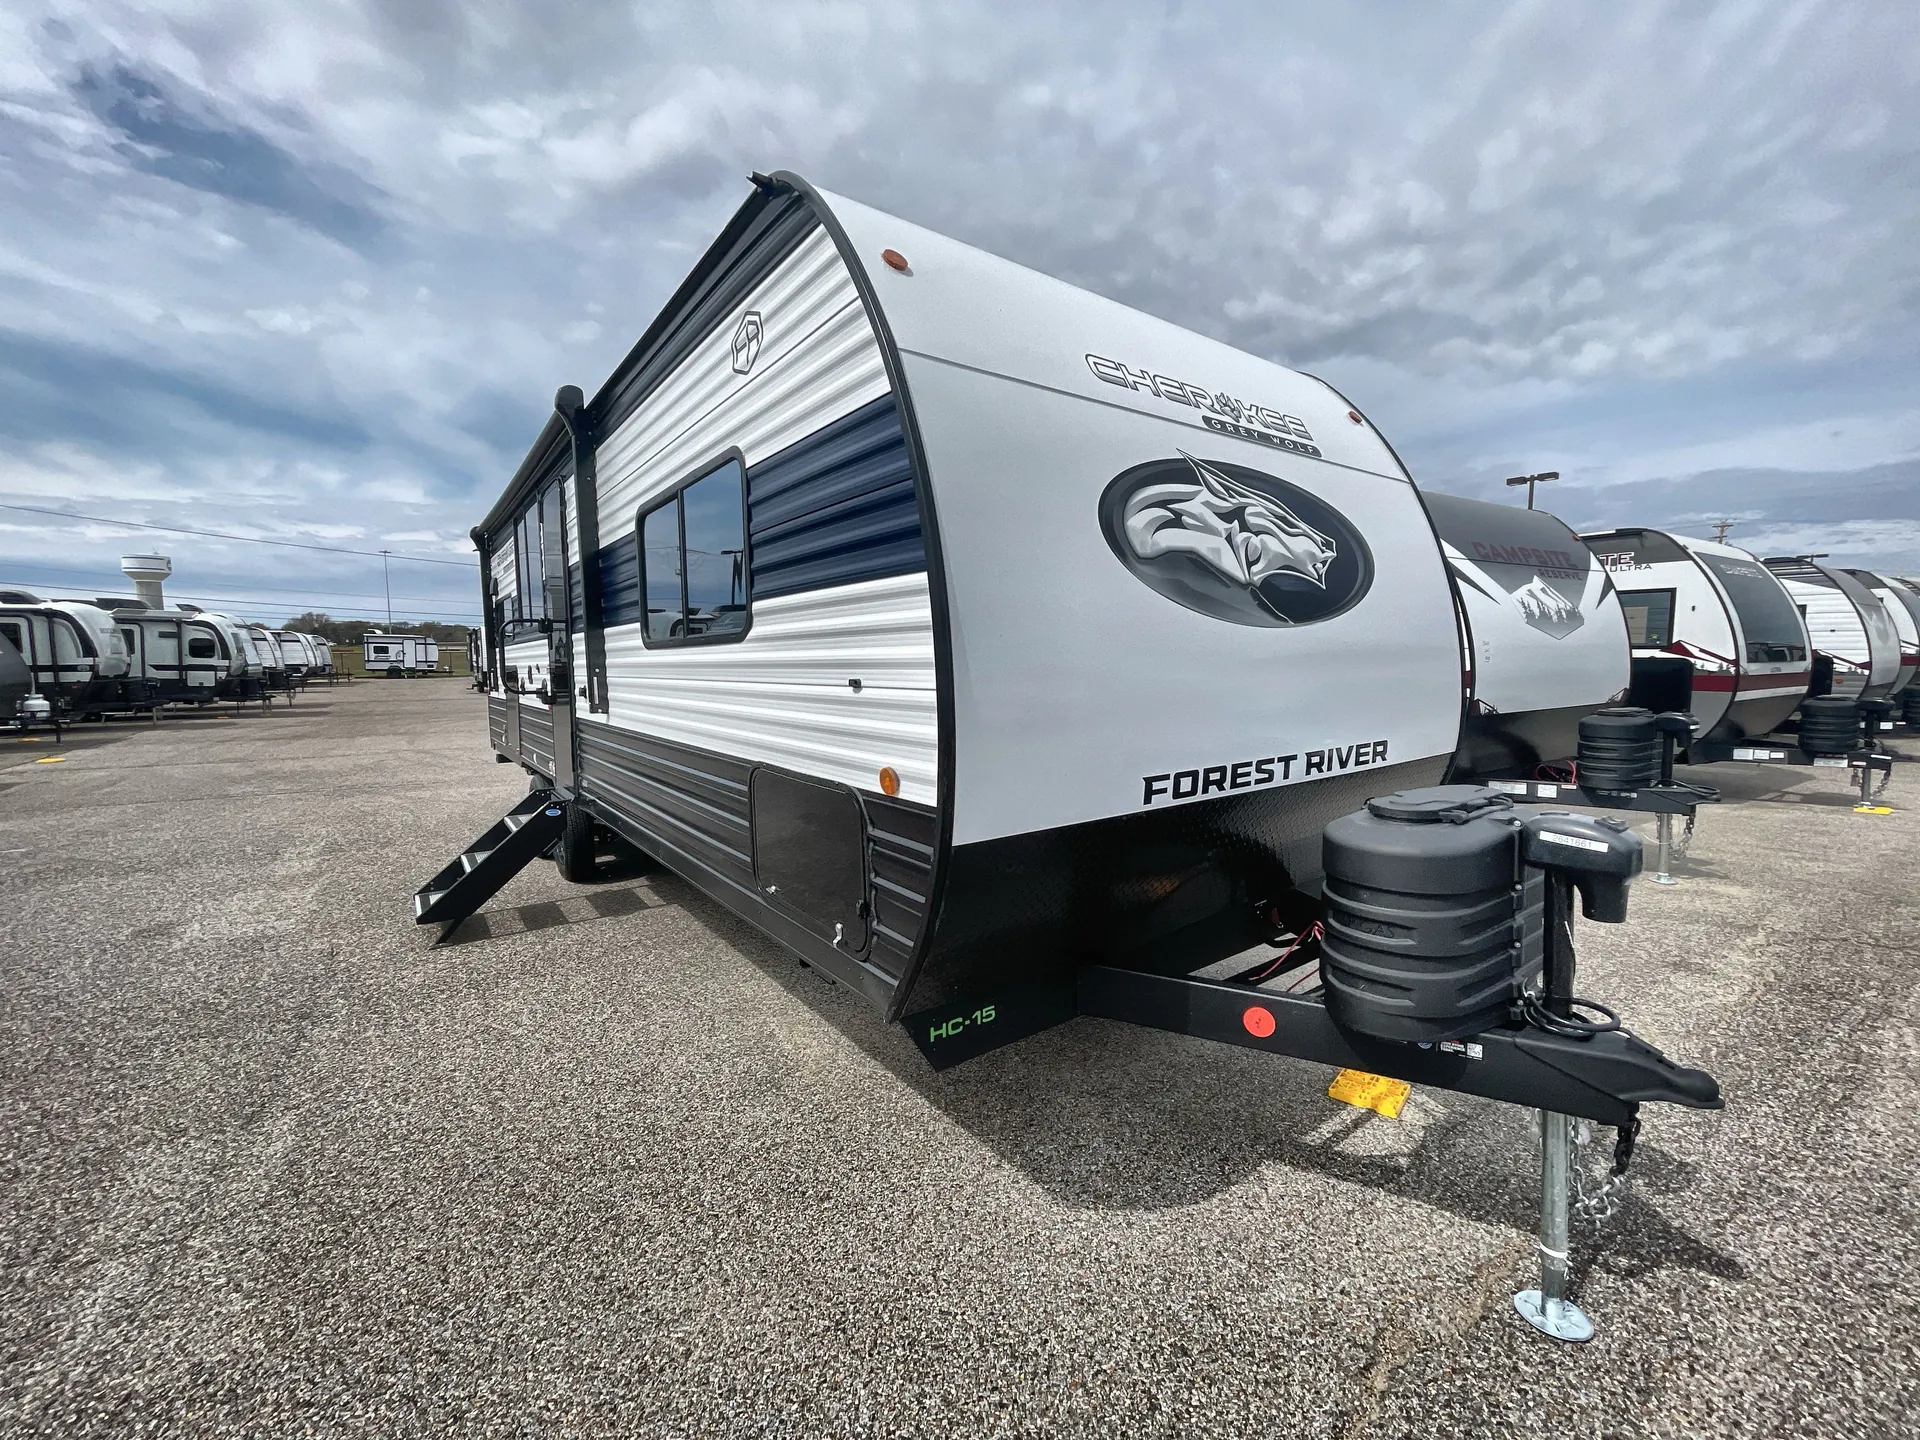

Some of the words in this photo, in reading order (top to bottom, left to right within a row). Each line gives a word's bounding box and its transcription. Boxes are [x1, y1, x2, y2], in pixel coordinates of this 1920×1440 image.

[1211, 420, 1260, 439] GREY
[1270, 435, 1316, 454] WOLF
[1472, 542, 1579, 568] CAMPSITE
[1610, 564, 1653, 573] ULTRA
[1539, 568, 1584, 580] RESERVE
[1142, 754, 1299, 806] FOREST
[1304, 740, 1388, 776] RIVER
[929, 1005, 996, 1043] HC-15
